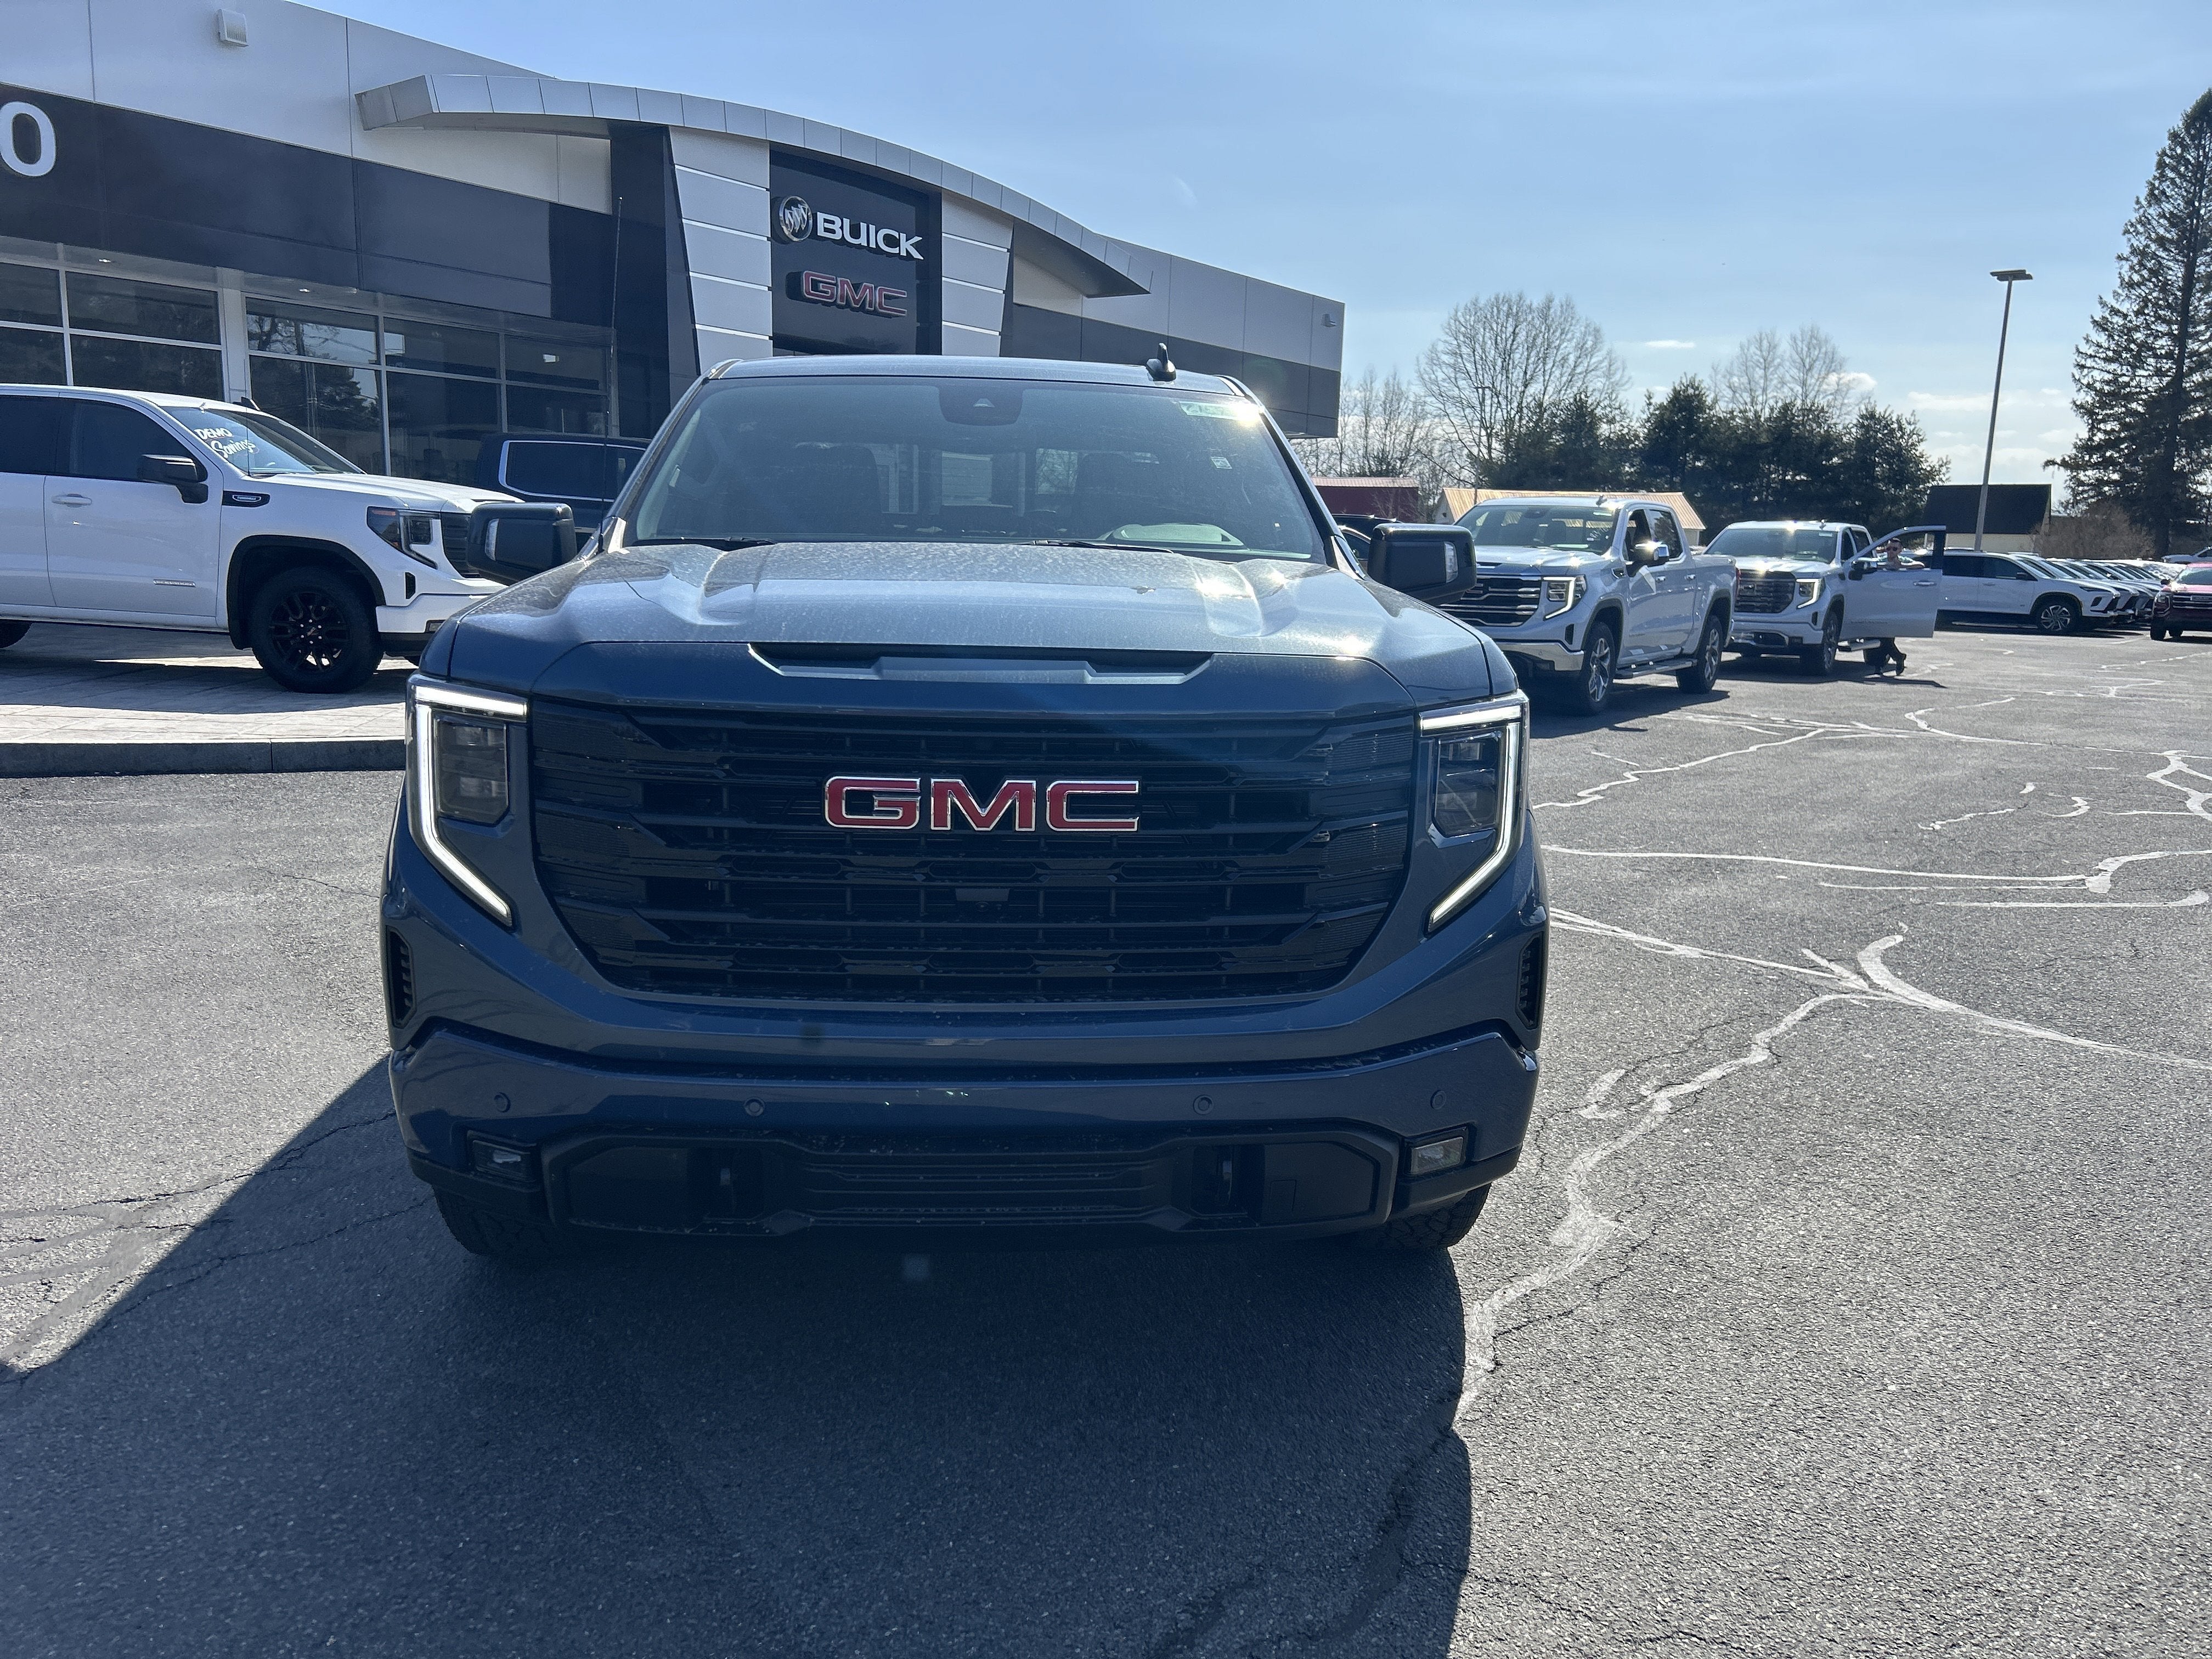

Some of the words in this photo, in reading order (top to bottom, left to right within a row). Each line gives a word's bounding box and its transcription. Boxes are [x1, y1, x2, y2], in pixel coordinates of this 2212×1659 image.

[816, 212, 924, 260] BUICK
[802, 270, 907, 316] GMC
[194, 427, 233, 440] DEMO
[211, 439, 257, 459] Savings
[825, 776, 1139, 832] GMC
